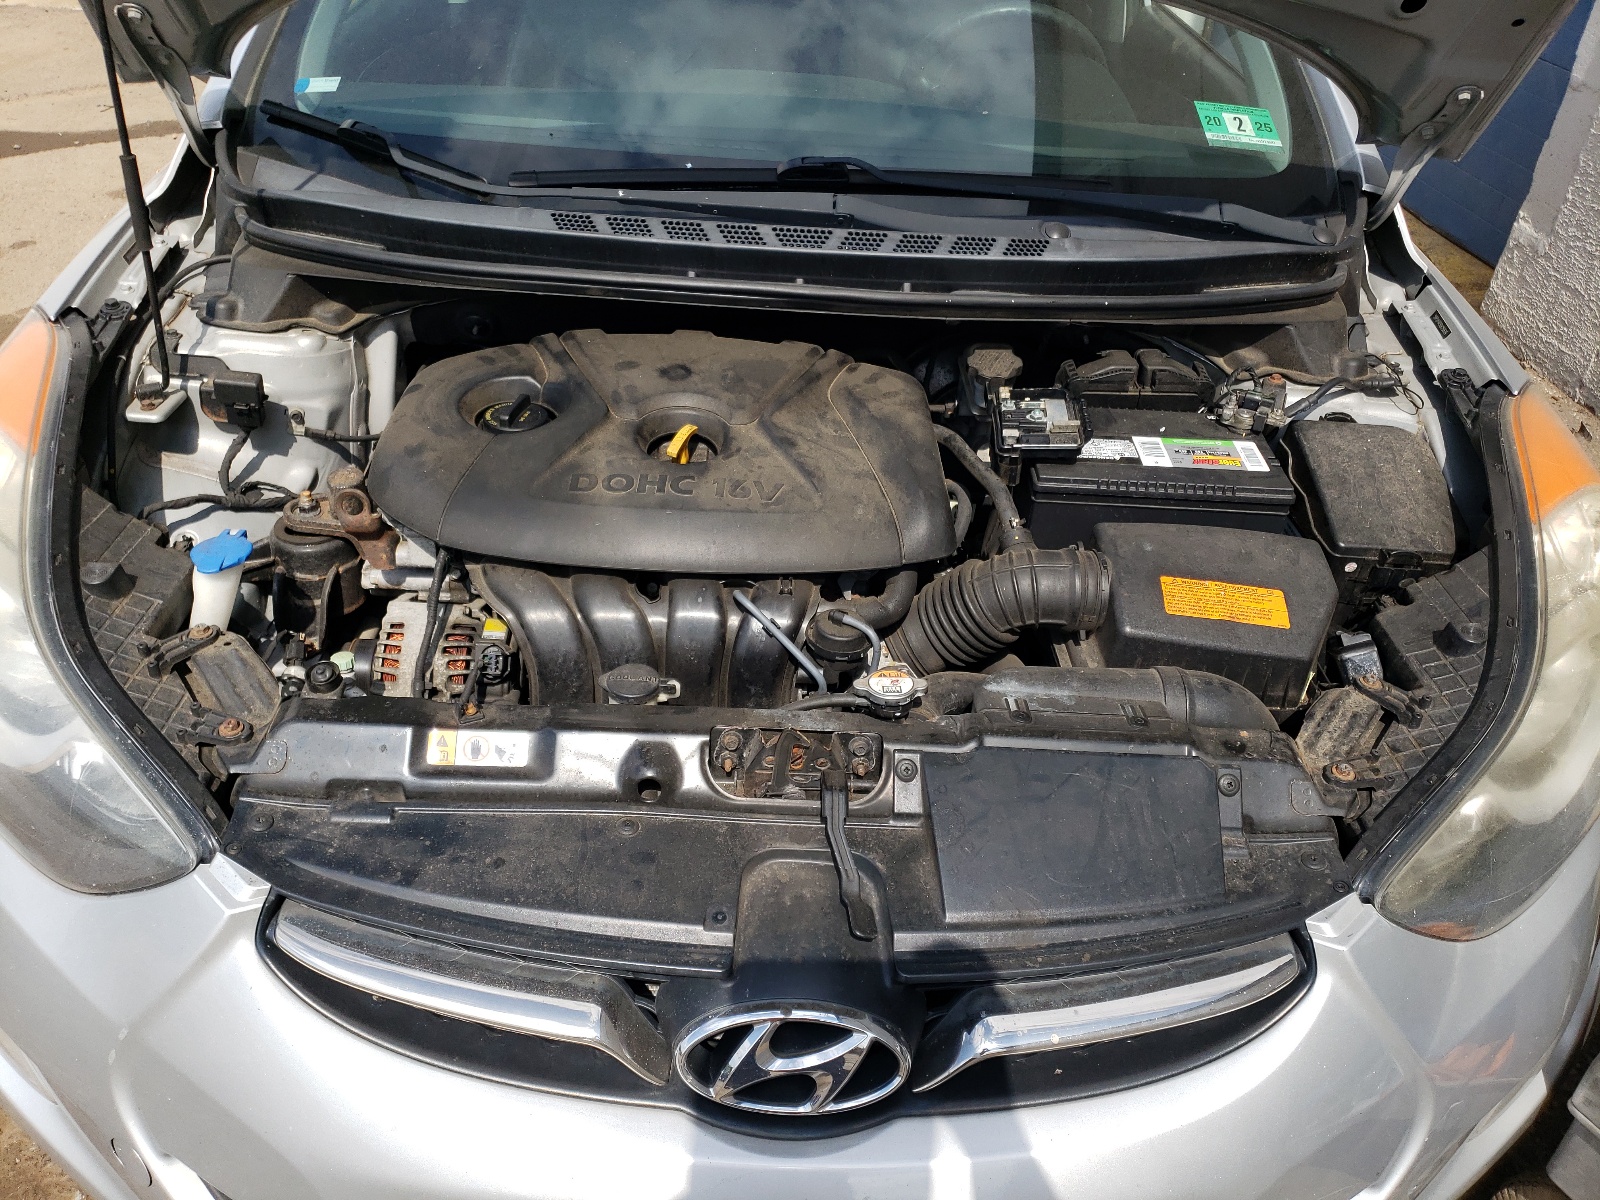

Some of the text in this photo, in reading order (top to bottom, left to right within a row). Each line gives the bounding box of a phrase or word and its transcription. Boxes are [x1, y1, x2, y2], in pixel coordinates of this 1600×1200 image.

[1204, 115, 1273, 133] 20 2 25
[568, 473, 785, 503] DOHC 16V
[608, 674, 657, 683] COOLANT
